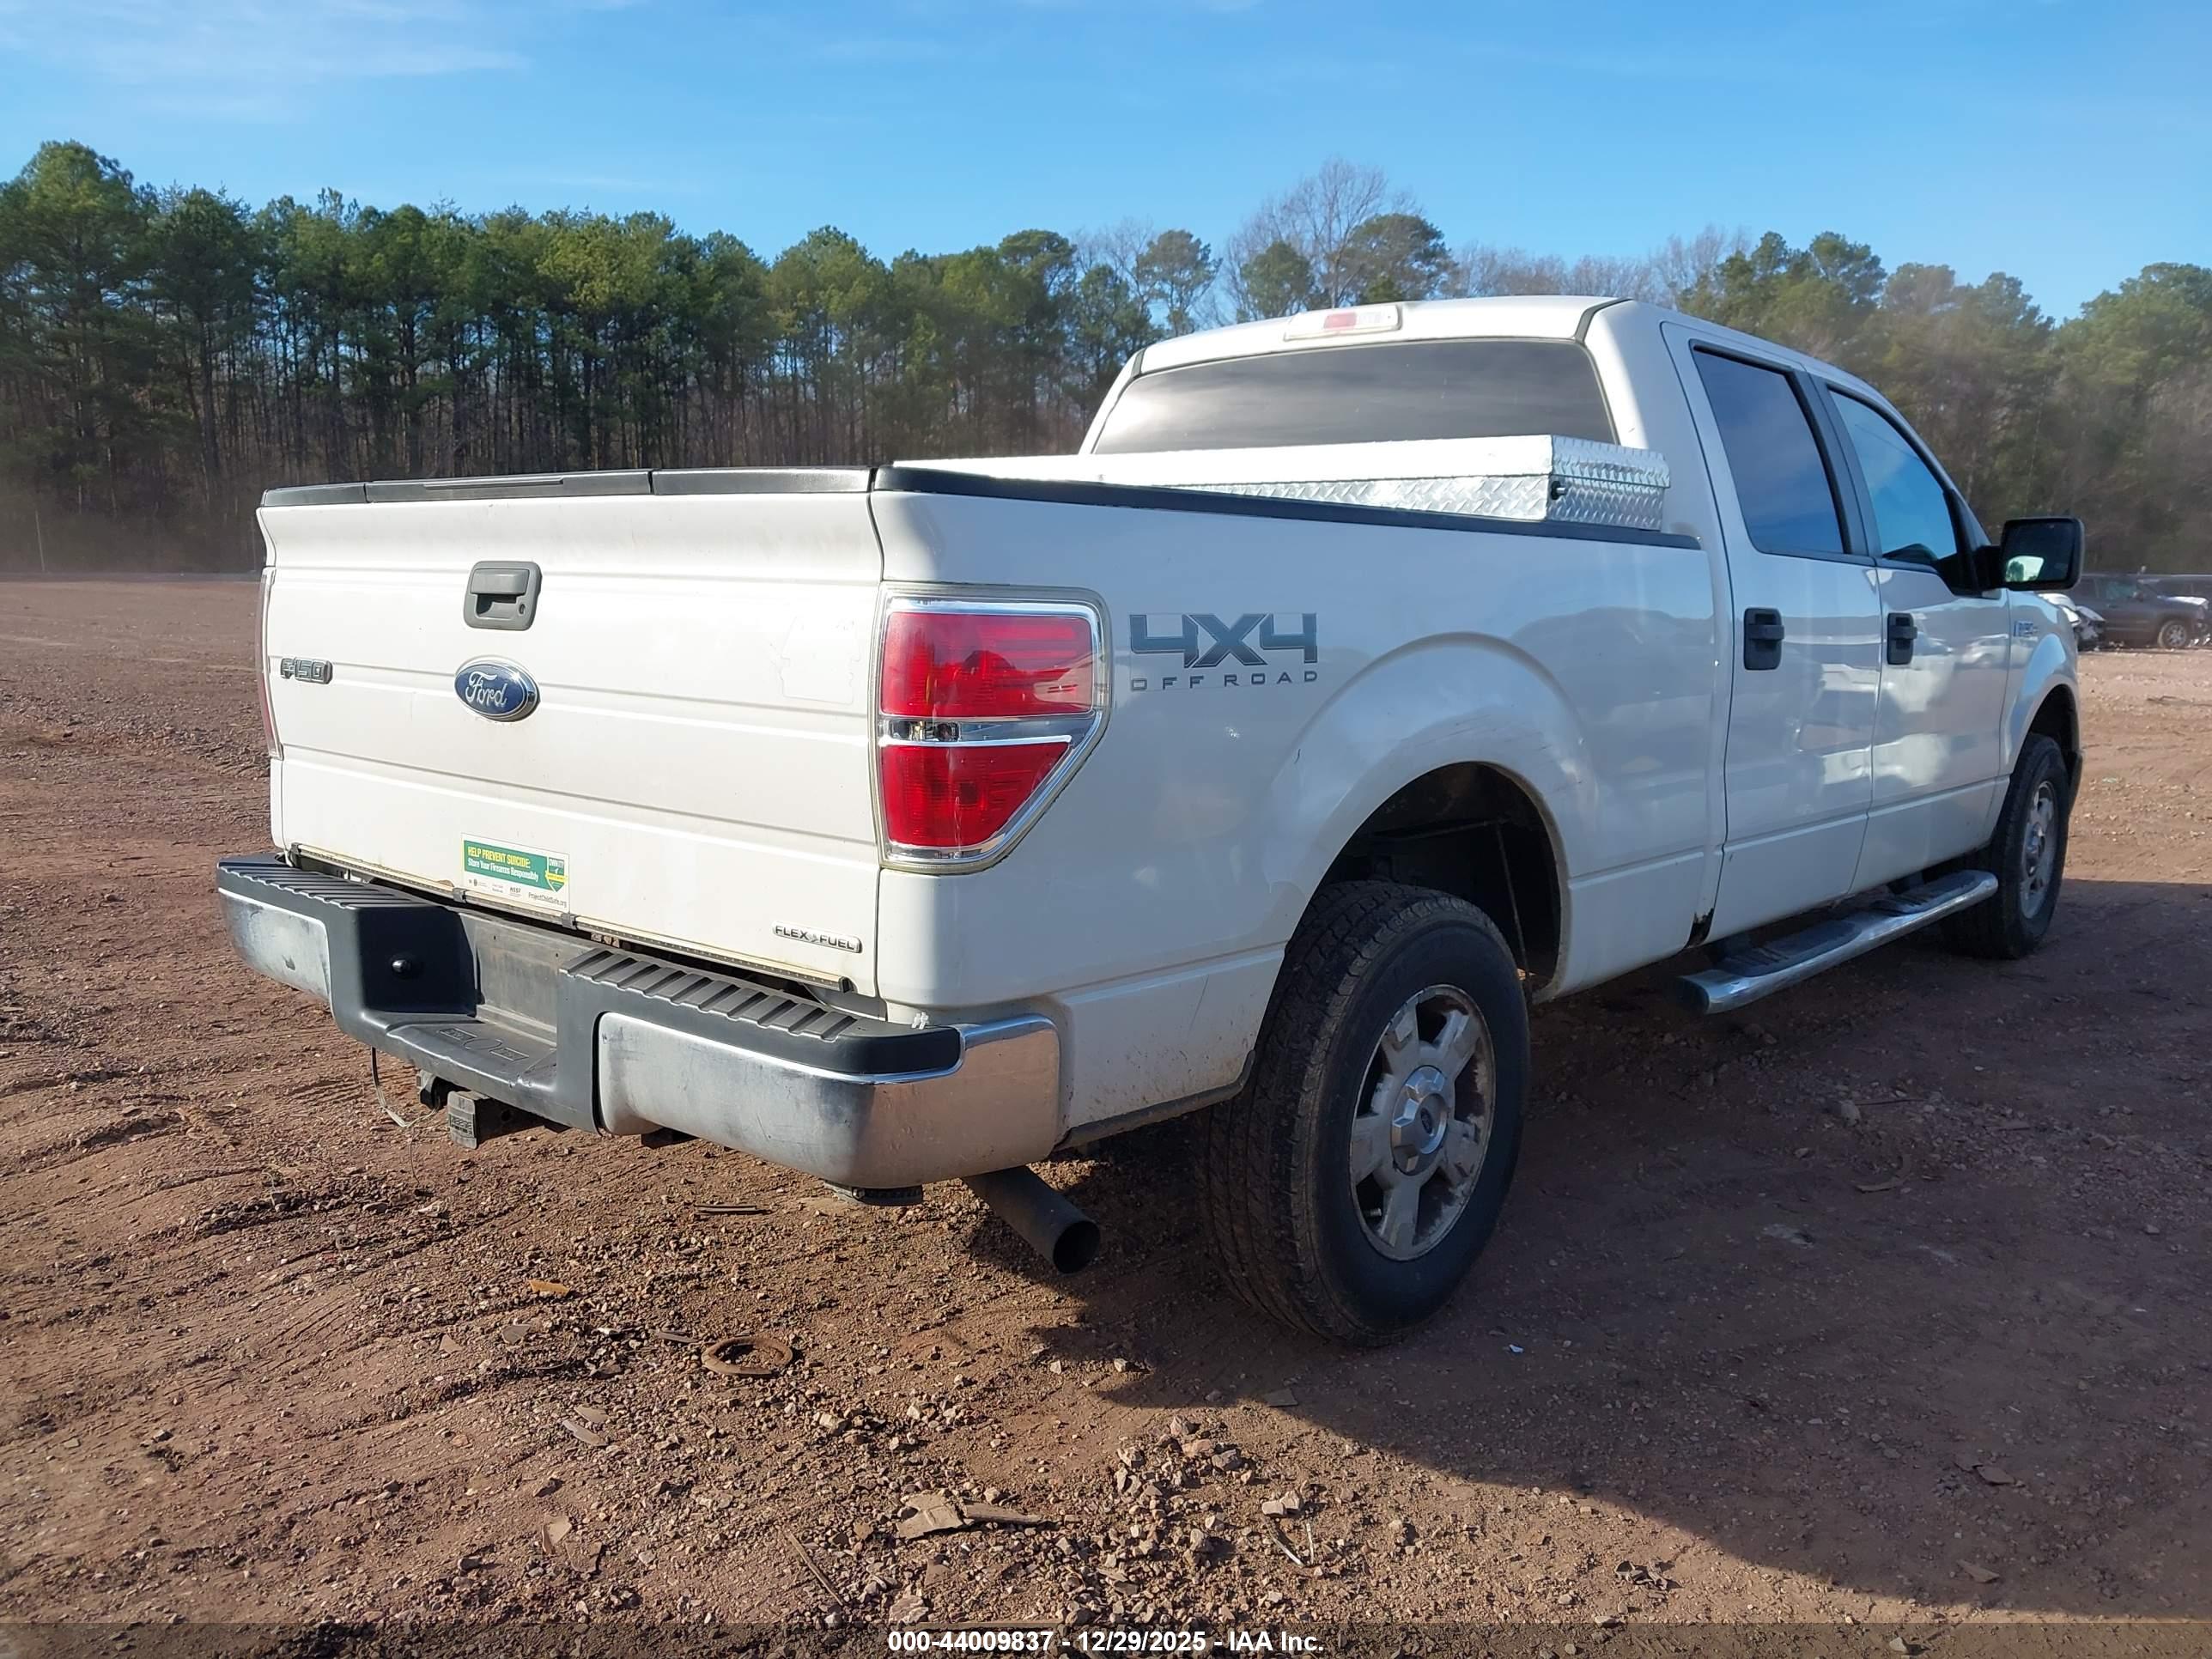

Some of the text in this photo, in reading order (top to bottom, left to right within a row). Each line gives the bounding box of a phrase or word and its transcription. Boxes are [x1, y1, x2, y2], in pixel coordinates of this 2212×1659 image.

[465, 672, 508, 708] Ford
[468, 847, 481, 857] HELP
[483, 849, 506, 863] PREVENT
[468, 858, 480, 868] Store
[480, 860, 490, 871] Your
[775, 926, 854, 951] FLEX FUEL
